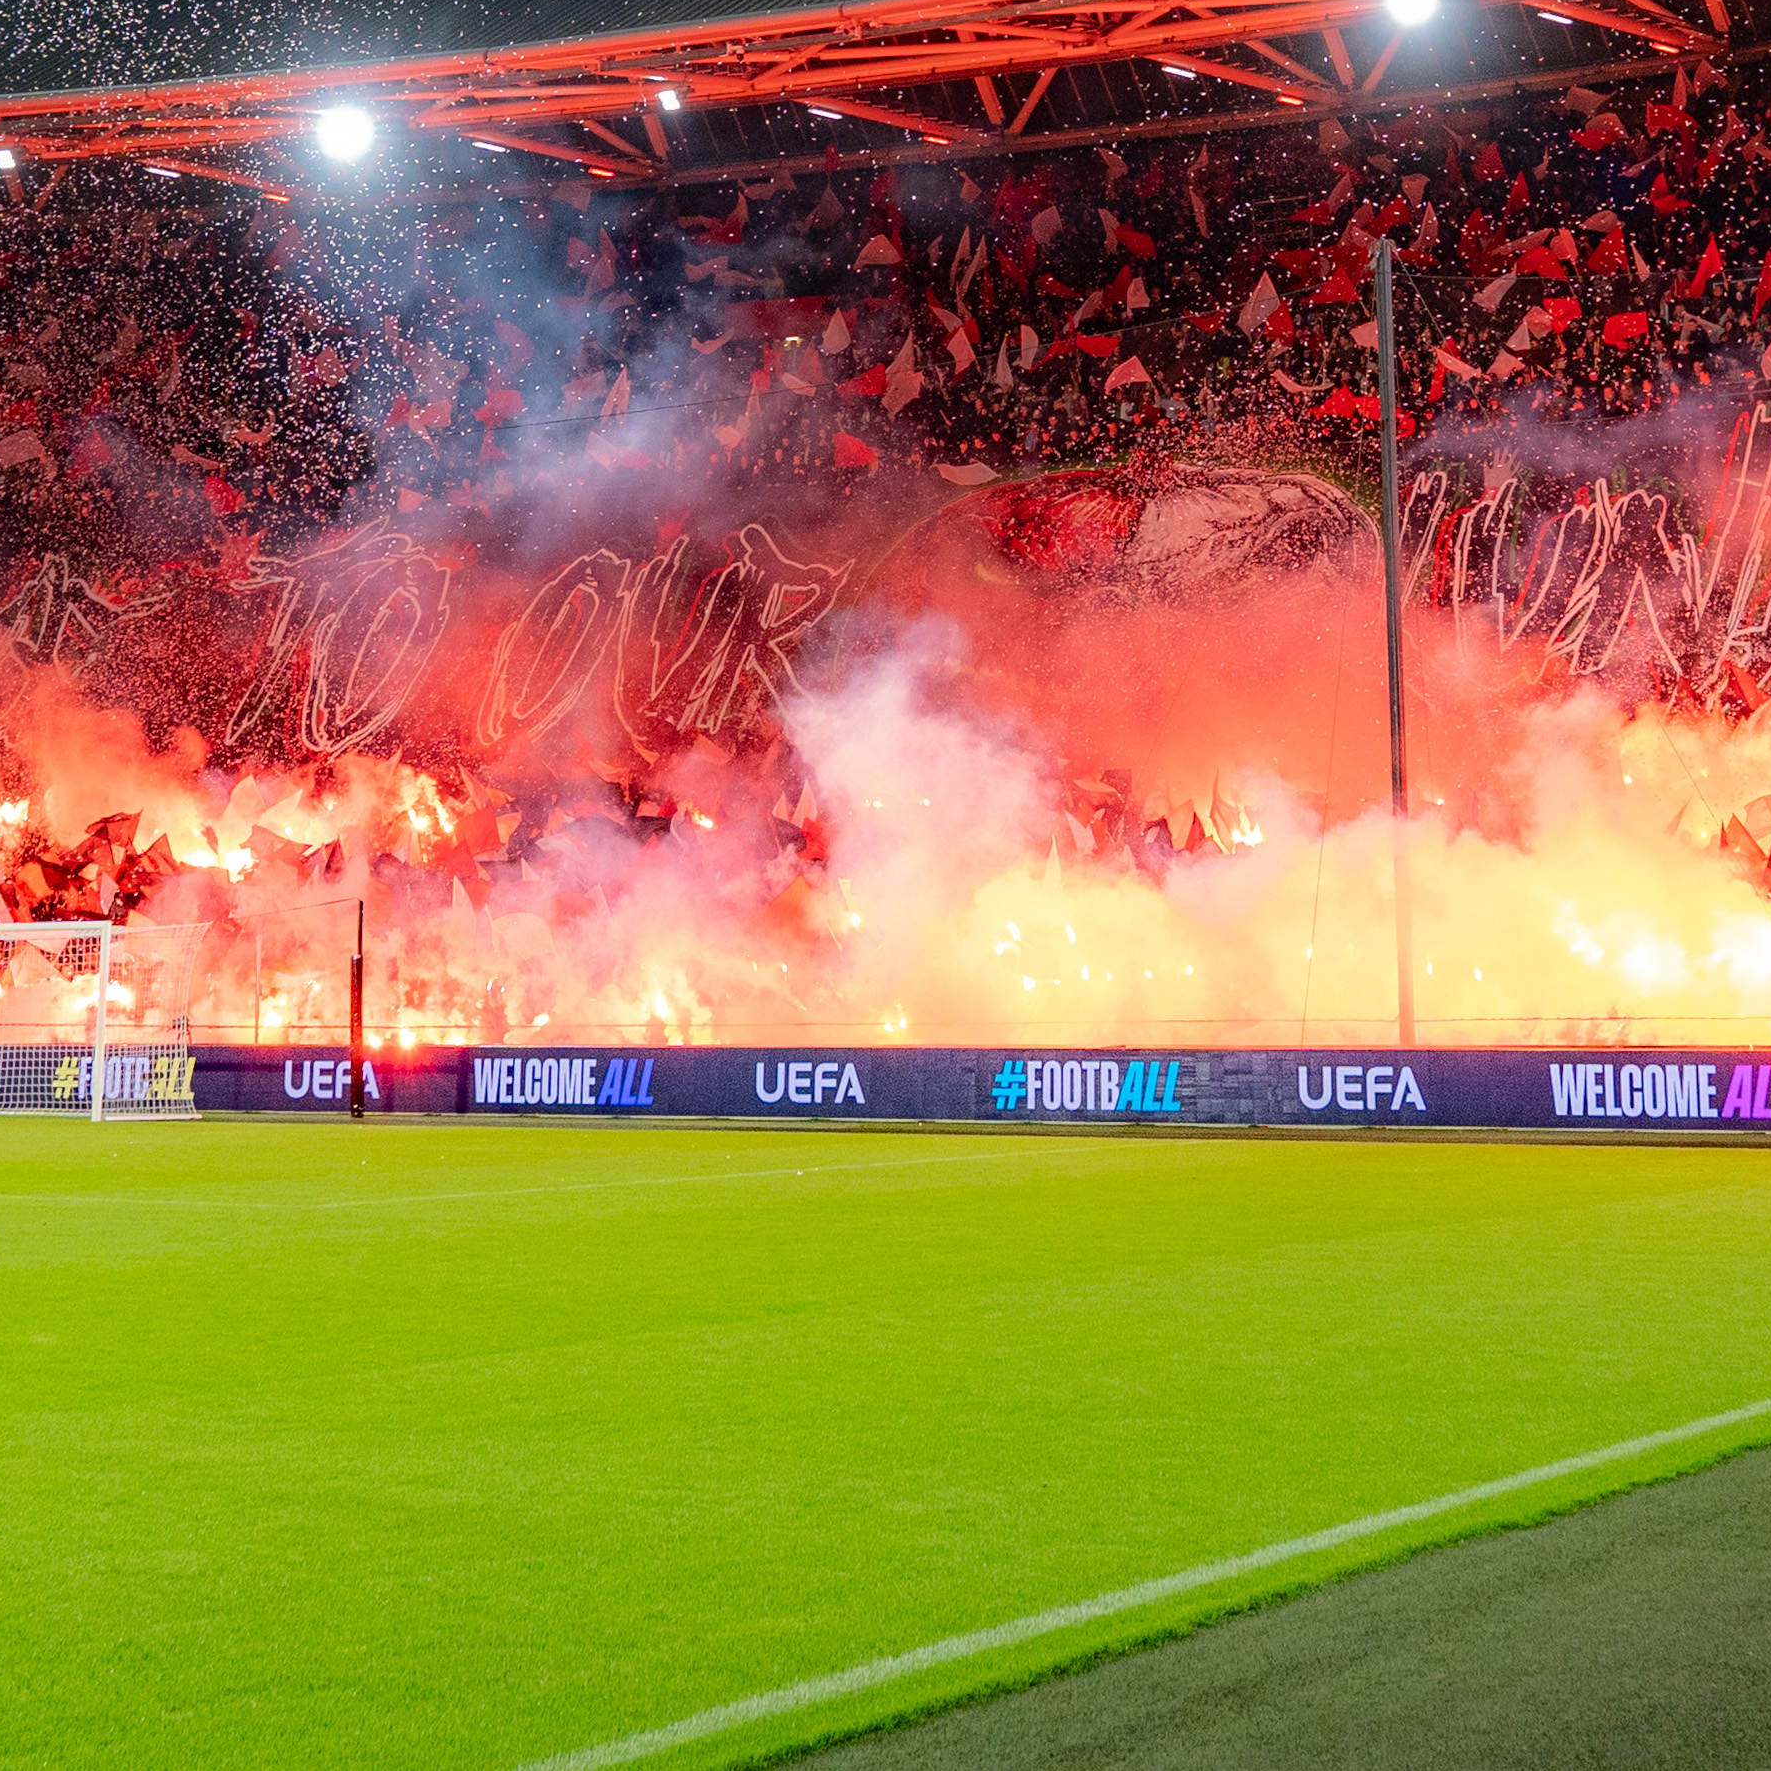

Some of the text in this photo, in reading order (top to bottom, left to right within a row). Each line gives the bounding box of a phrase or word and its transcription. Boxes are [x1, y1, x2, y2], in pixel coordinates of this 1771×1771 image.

[227, 519, 450, 757] TO
[477, 523, 855, 761] OUR
[283, 1060, 381, 1100] UEFA
[473, 1057, 655, 1105] WELCOME ALL
[755, 1061, 866, 1105] UEFA
[990, 1059, 1182, 1113] #FOOTBALL
[1297, 1065, 1427, 1111] UEFA
[1549, 1063, 1720, 1119] WELCOME
